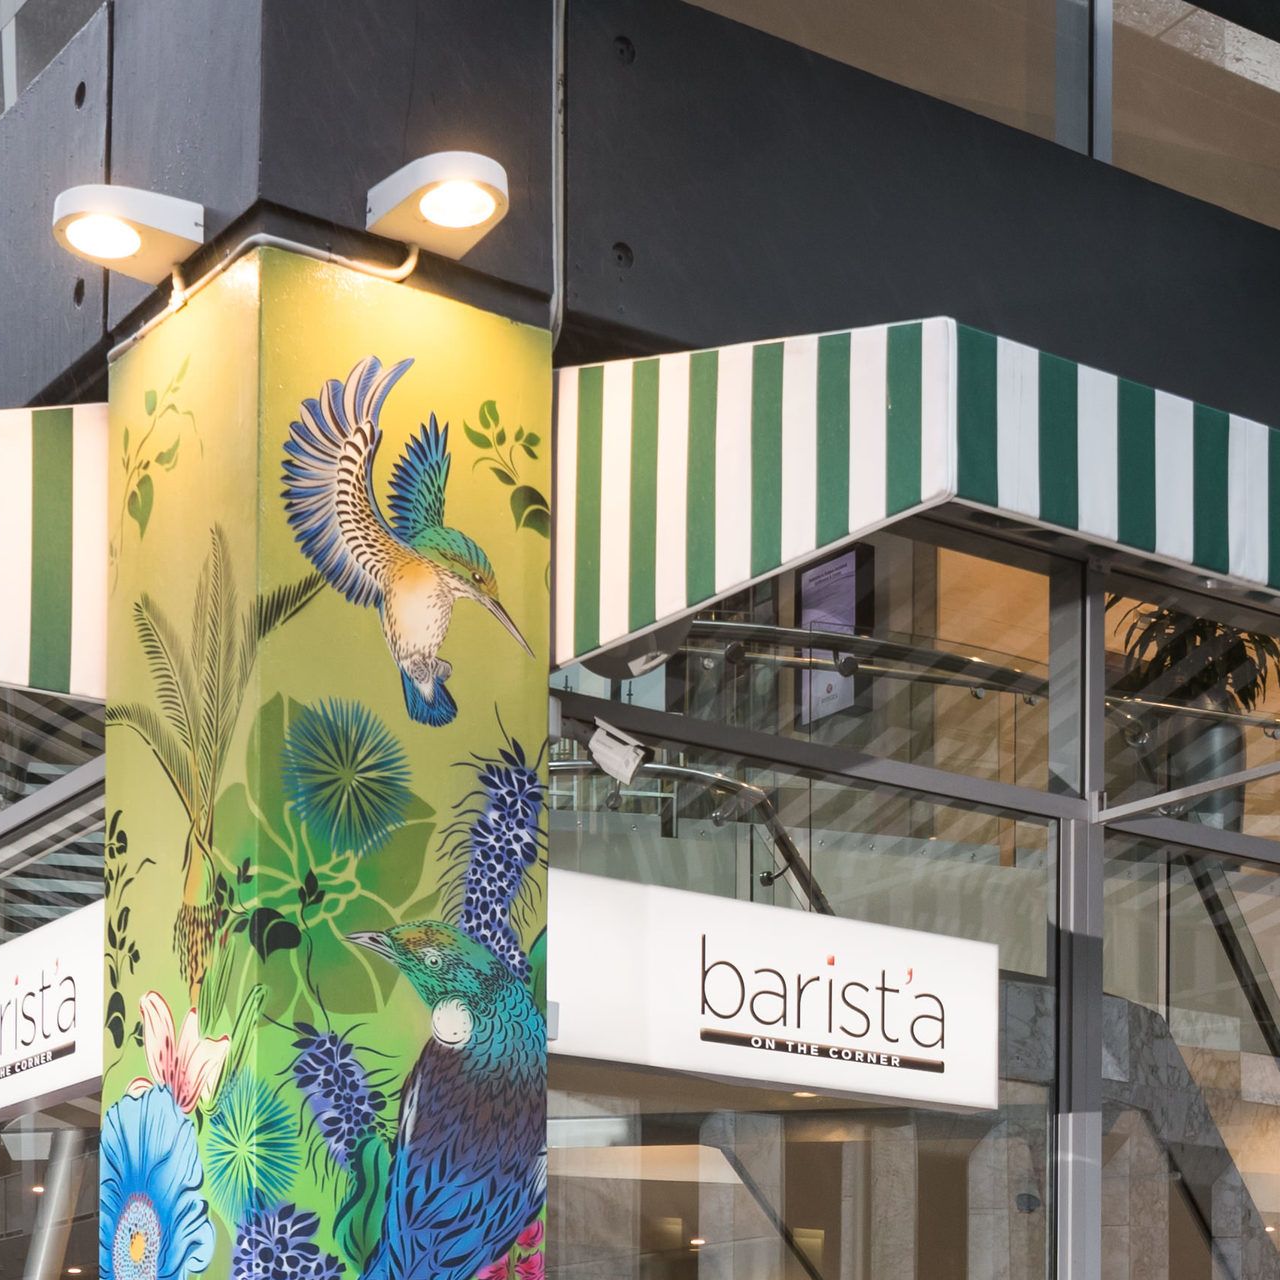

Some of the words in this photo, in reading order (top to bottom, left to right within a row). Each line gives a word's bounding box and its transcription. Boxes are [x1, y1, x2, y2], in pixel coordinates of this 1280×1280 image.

[14, 1051, 53, 1073] CORNER
[750, 1036, 775, 1050] ON
[786, 1041, 819, 1056] THE
[829, 1047, 901, 1067] CORNER
